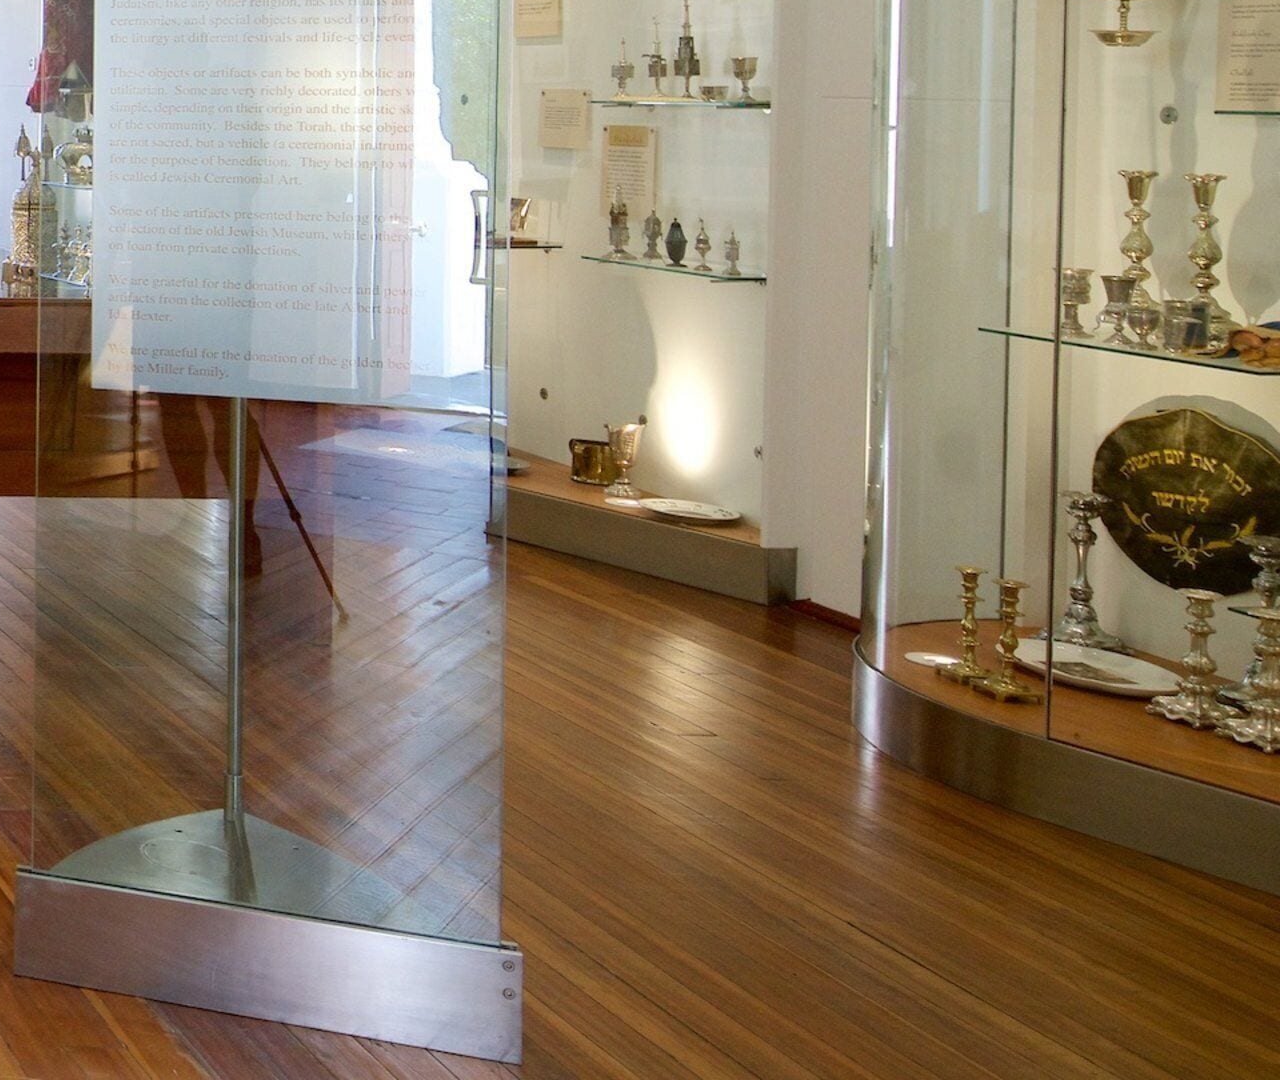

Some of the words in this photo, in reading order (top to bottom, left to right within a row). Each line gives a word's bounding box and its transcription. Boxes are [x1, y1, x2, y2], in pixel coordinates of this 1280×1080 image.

[190, 0, 213, 11] any
[183, 14, 206, 26] and
[208, 14, 251, 28] special
[253, 14, 298, 28] objects
[300, 17, 321, 25] are
[323, 13, 354, 25] used
[110, 32, 128, 43] the
[130, 32, 171, 46] liturgy
[172, 34, 185, 43] at
[187, 31, 240, 43] different
[242, 31, 293, 43] festivals
[295, 31, 320, 43] and
[110, 67, 145, 78] These
[147, 67, 190, 81] objects
[192, 70, 206, 78] or
[208, 67, 258, 78] artifacts
[260, 70, 283, 78] can
[285, 67, 302, 78] be
[304, 67, 333, 78] both
[110, 119, 122, 130] of
[123, 119, 143, 130] the
[223, 120, 272, 131] Besides
[273, 120, 294, 132] the
[109, 171, 119, 182] is
[121, 171, 158, 183] called
[159, 172, 201, 183] Jewish
[203, 172, 274, 184] Ceremonial
[109, 206, 143, 217] Some
[144, 206, 159, 218] of
[160, 207, 180, 218] the
[182, 207, 231, 219] artifacts
[233, 208, 293, 224] presented
[295, 210, 324, 222] here
[109, 244, 124, 252] on
[126, 241, 152, 252] loan
[154, 242, 185, 253] from
[186, 243, 229, 258] private
[108, 275, 127, 286] We
[129, 278, 149, 287] are
[151, 276, 199, 292] grateful
[201, 278, 220, 290] for
[222, 278, 242, 290] the
[244, 279, 299, 292] donation
[300, 281, 316, 293] of
[318, 282, 353, 294] silver
[108, 292, 156, 305] artifacts
[157, 294, 188, 306] from
[190, 295, 209, 307] the
[211, 296, 273, 310] collection
[274, 298, 289, 310] of
[291, 299, 312, 311] the
[314, 300, 339, 312] late
